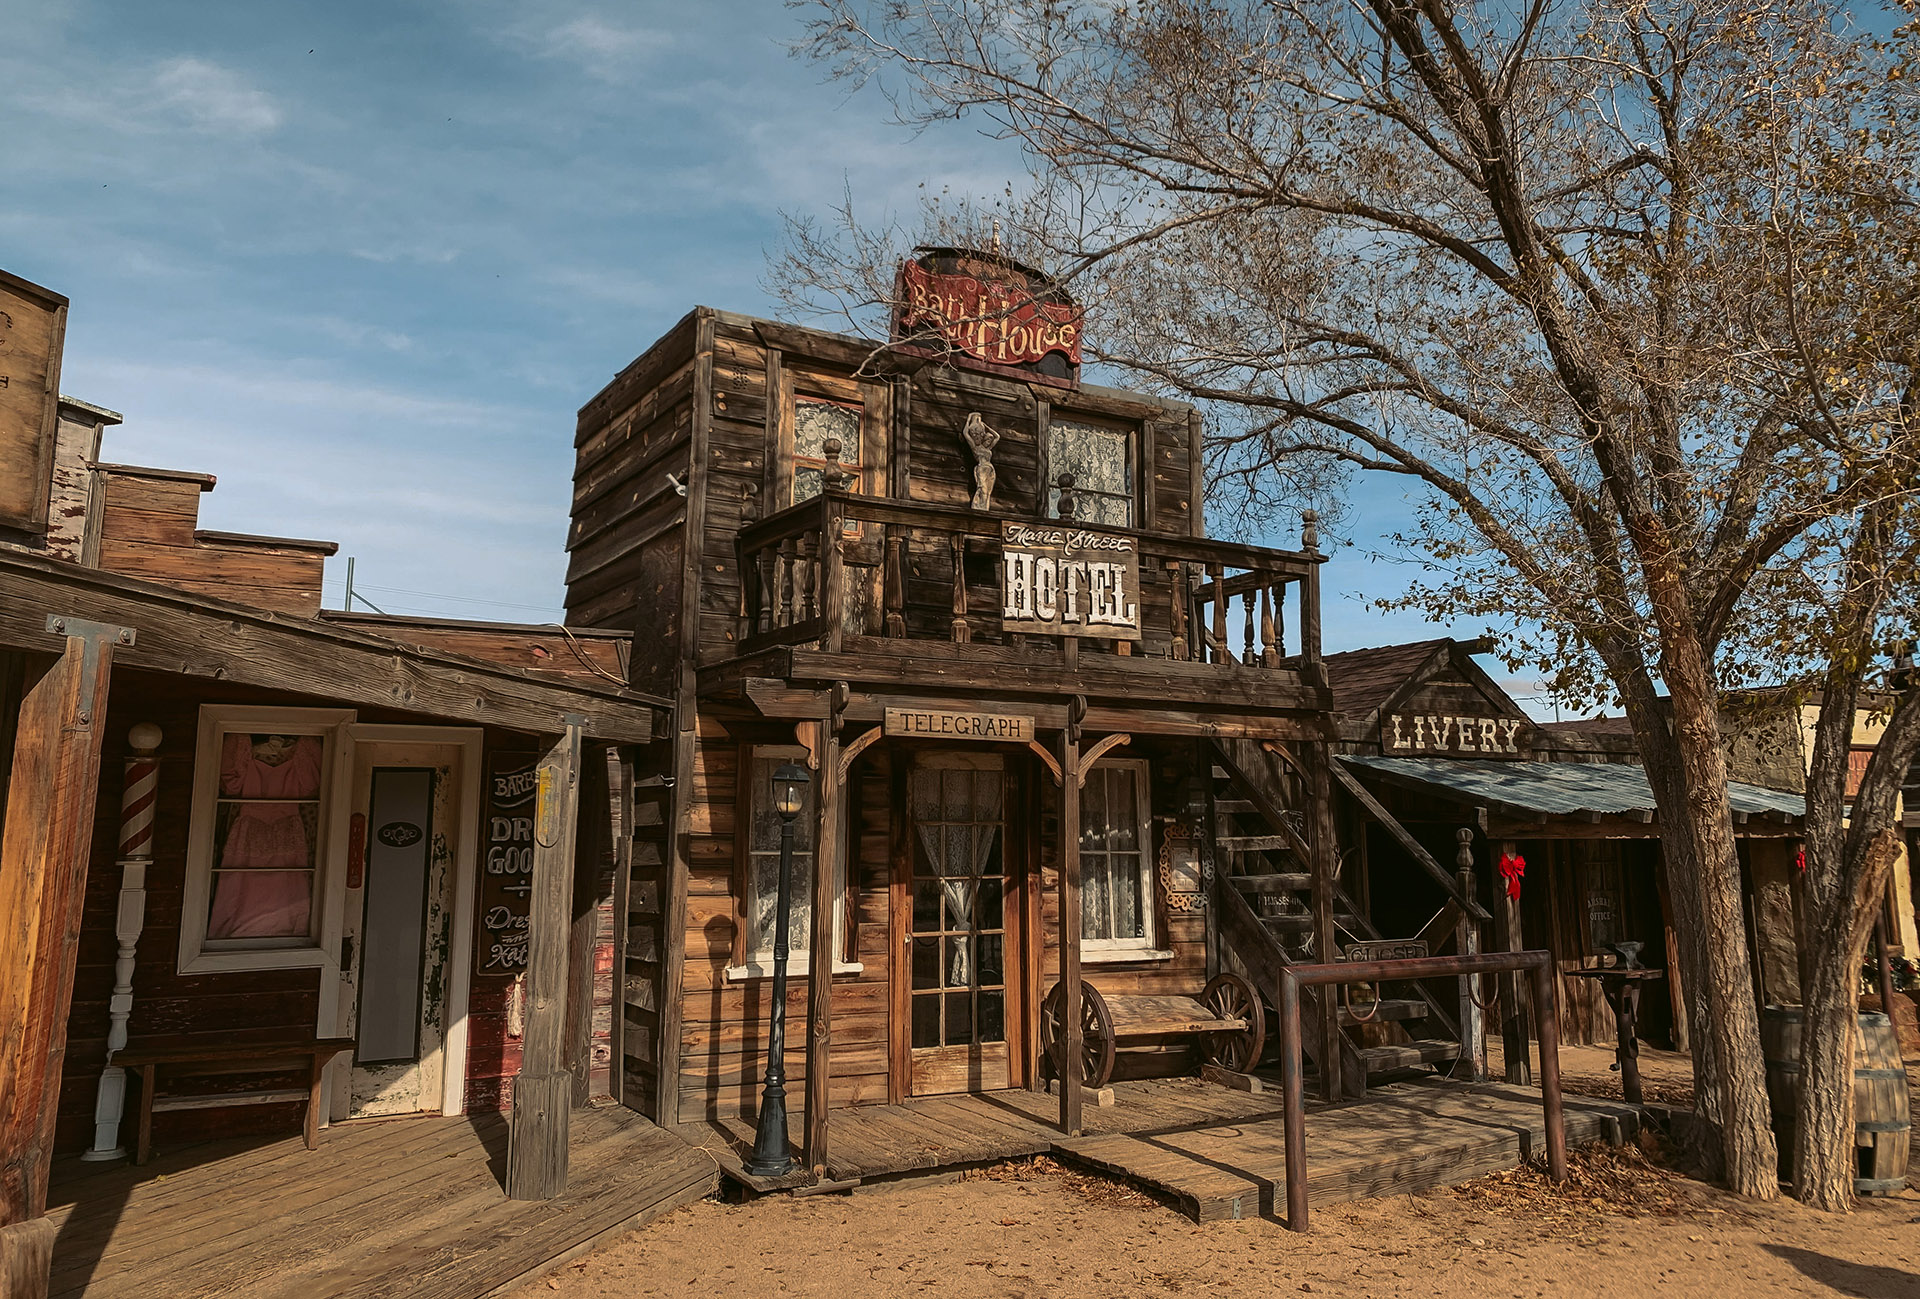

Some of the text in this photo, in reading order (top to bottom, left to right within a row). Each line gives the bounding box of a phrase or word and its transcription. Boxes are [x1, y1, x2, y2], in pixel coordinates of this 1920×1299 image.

[913, 284, 1076, 359] Bath House
[1004, 525, 1133, 556] Mane Street
[1003, 550, 1136, 626] HOTEL
[900, 713, 1021, 737] TELEGRAPH
[1391, 714, 1520, 753] LIVERY
[495, 771, 535, 797] BARB
[491, 816, 533, 841] DR
[487, 846, 533, 874] GOO
[484, 905, 531, 929] Dres
